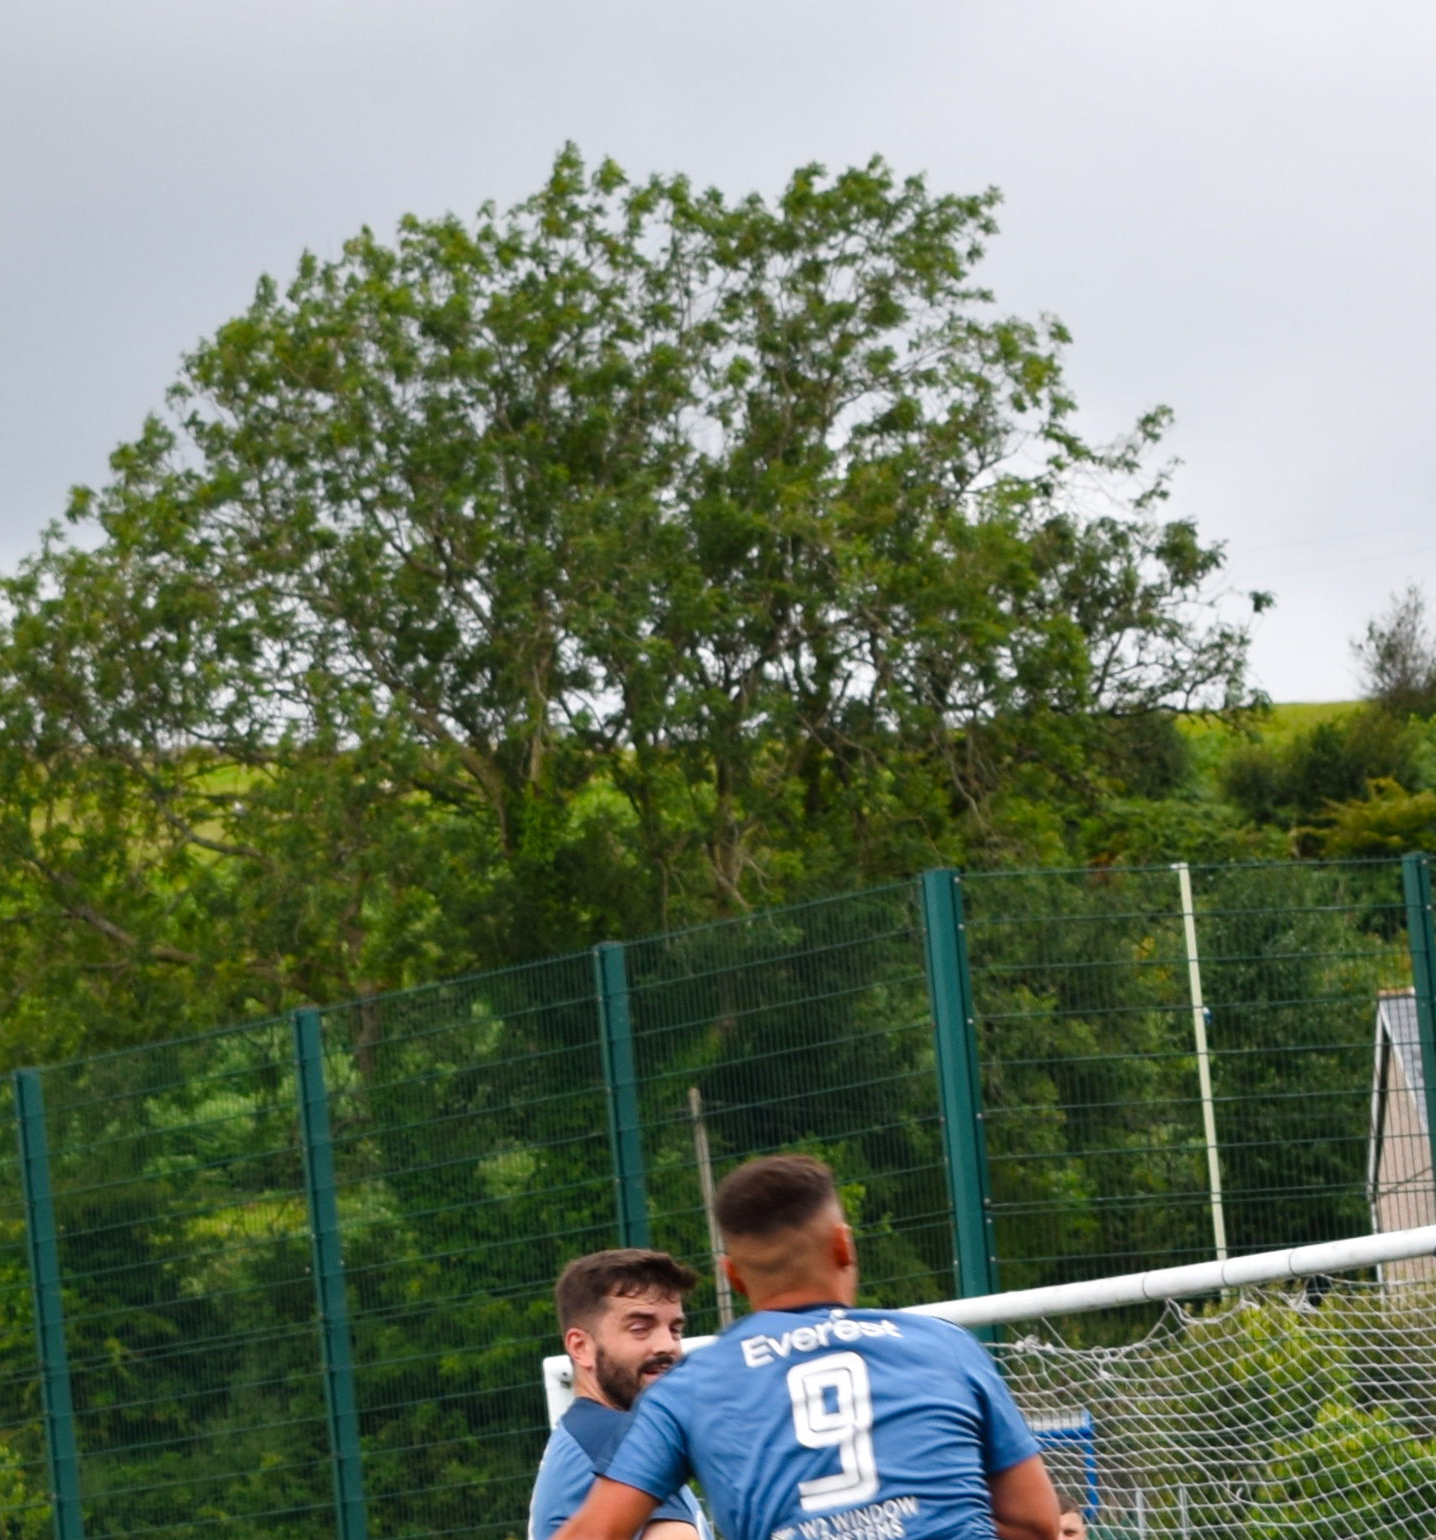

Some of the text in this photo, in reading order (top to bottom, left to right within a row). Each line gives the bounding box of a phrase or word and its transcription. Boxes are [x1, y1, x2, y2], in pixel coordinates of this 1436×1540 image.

[741, 1317, 904, 1368] Everest
[787, 1351, 880, 1512] 9
[829, 1496, 919, 1533] WINDOW
